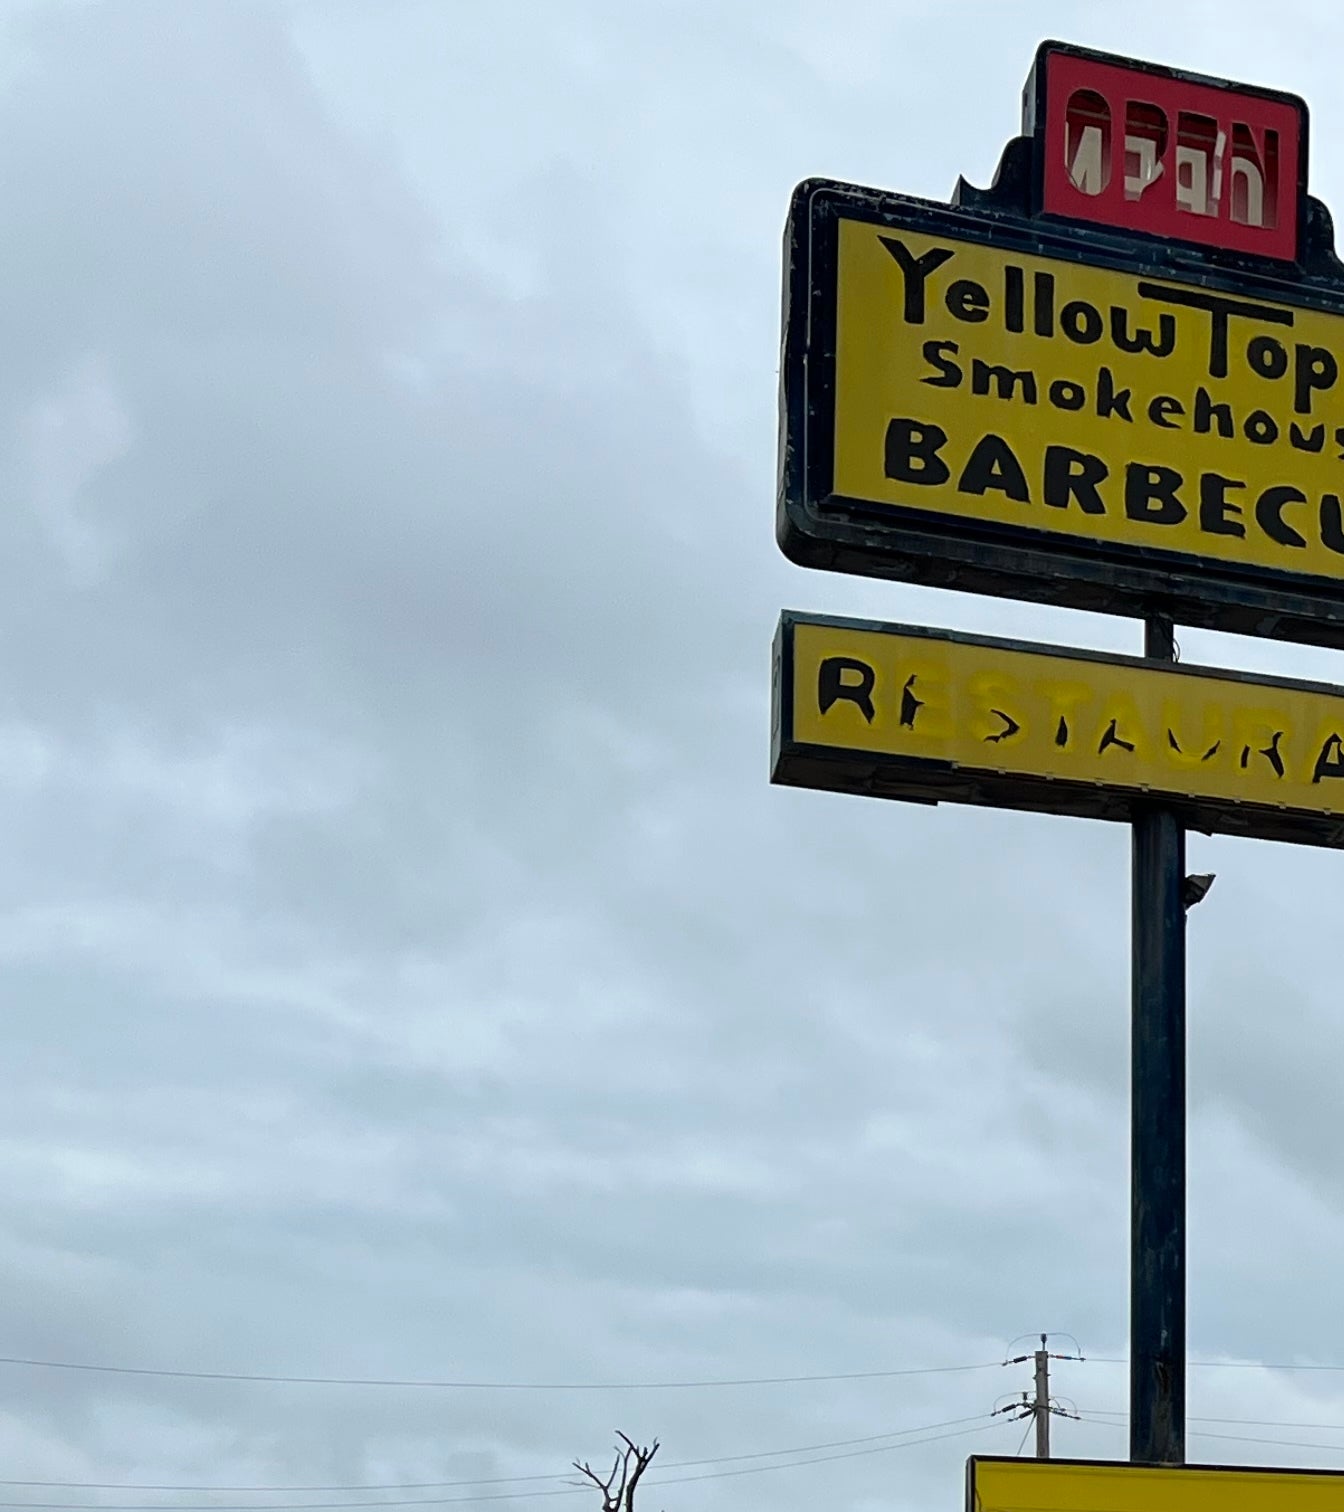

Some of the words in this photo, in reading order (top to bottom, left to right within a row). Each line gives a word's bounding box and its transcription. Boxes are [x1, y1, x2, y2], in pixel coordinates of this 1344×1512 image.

[1064, 87, 1279, 230] OPEN
[879, 234, 1175, 359] Yellow
[1138, 282, 1339, 413] Top
